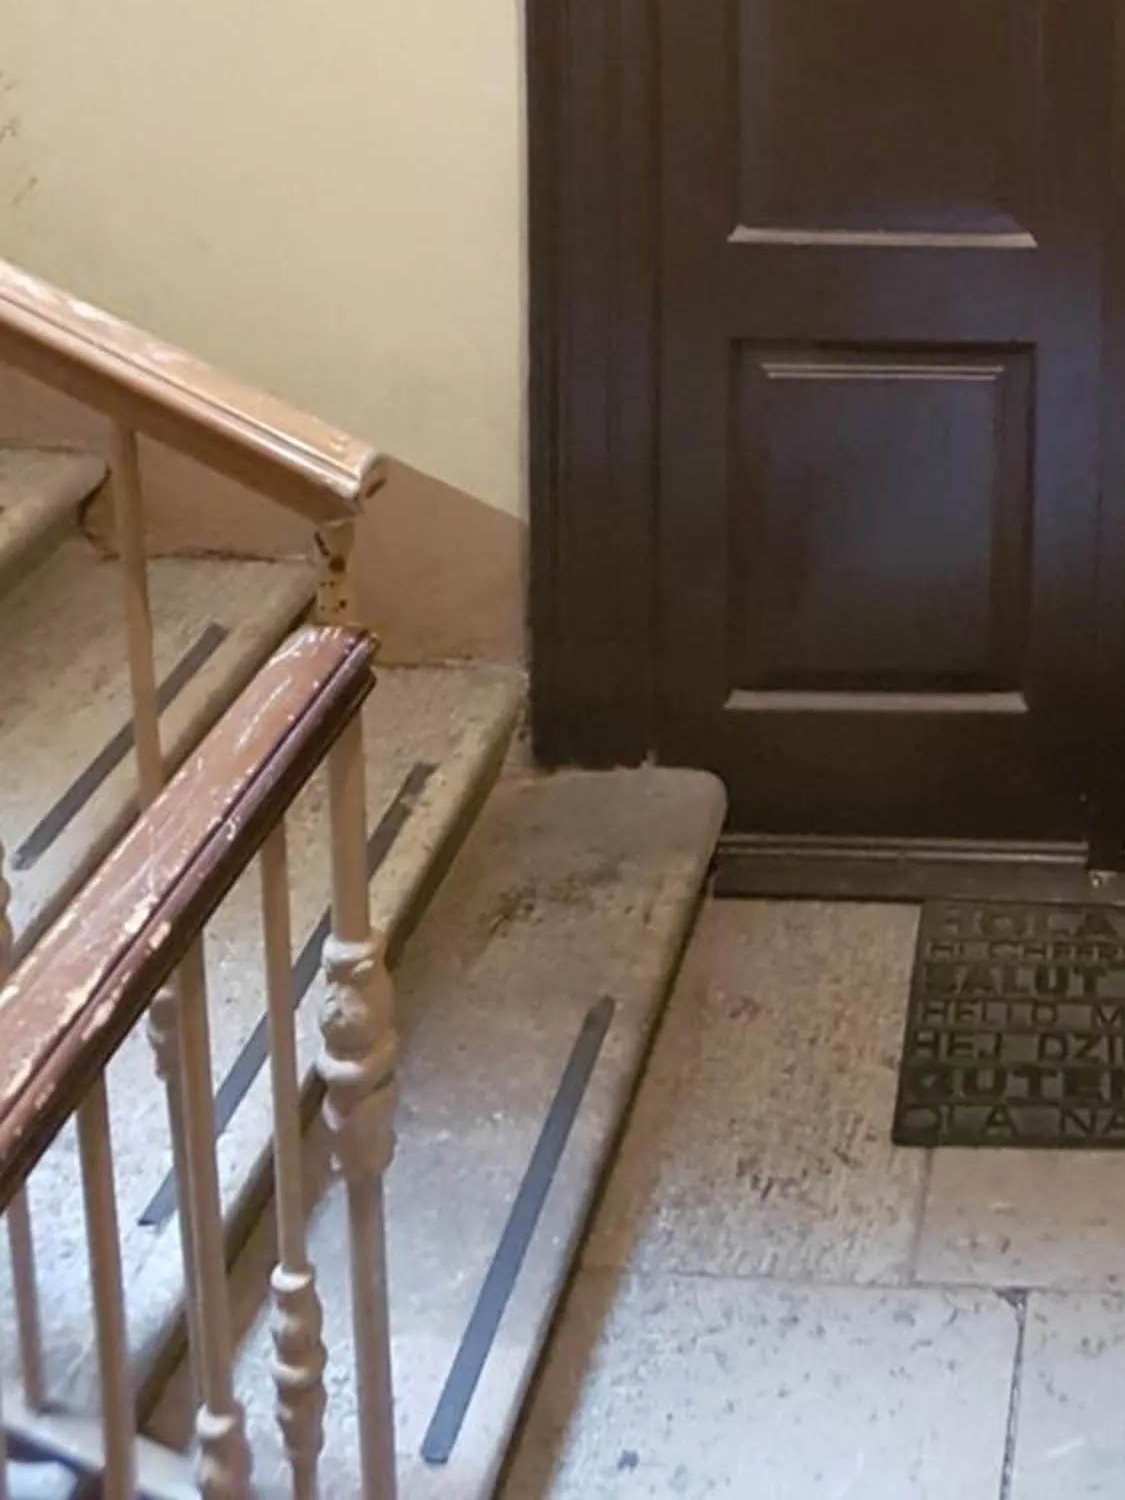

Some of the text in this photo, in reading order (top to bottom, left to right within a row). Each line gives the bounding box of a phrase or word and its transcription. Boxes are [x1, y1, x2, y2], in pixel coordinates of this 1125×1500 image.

[937, 904, 1117, 940] HOLA
[925, 962, 1107, 996] SALUT
[921, 999, 1058, 1028] HELLO
[912, 1030, 1003, 1060] HEJ
[899, 1103, 1019, 1138] OLA
